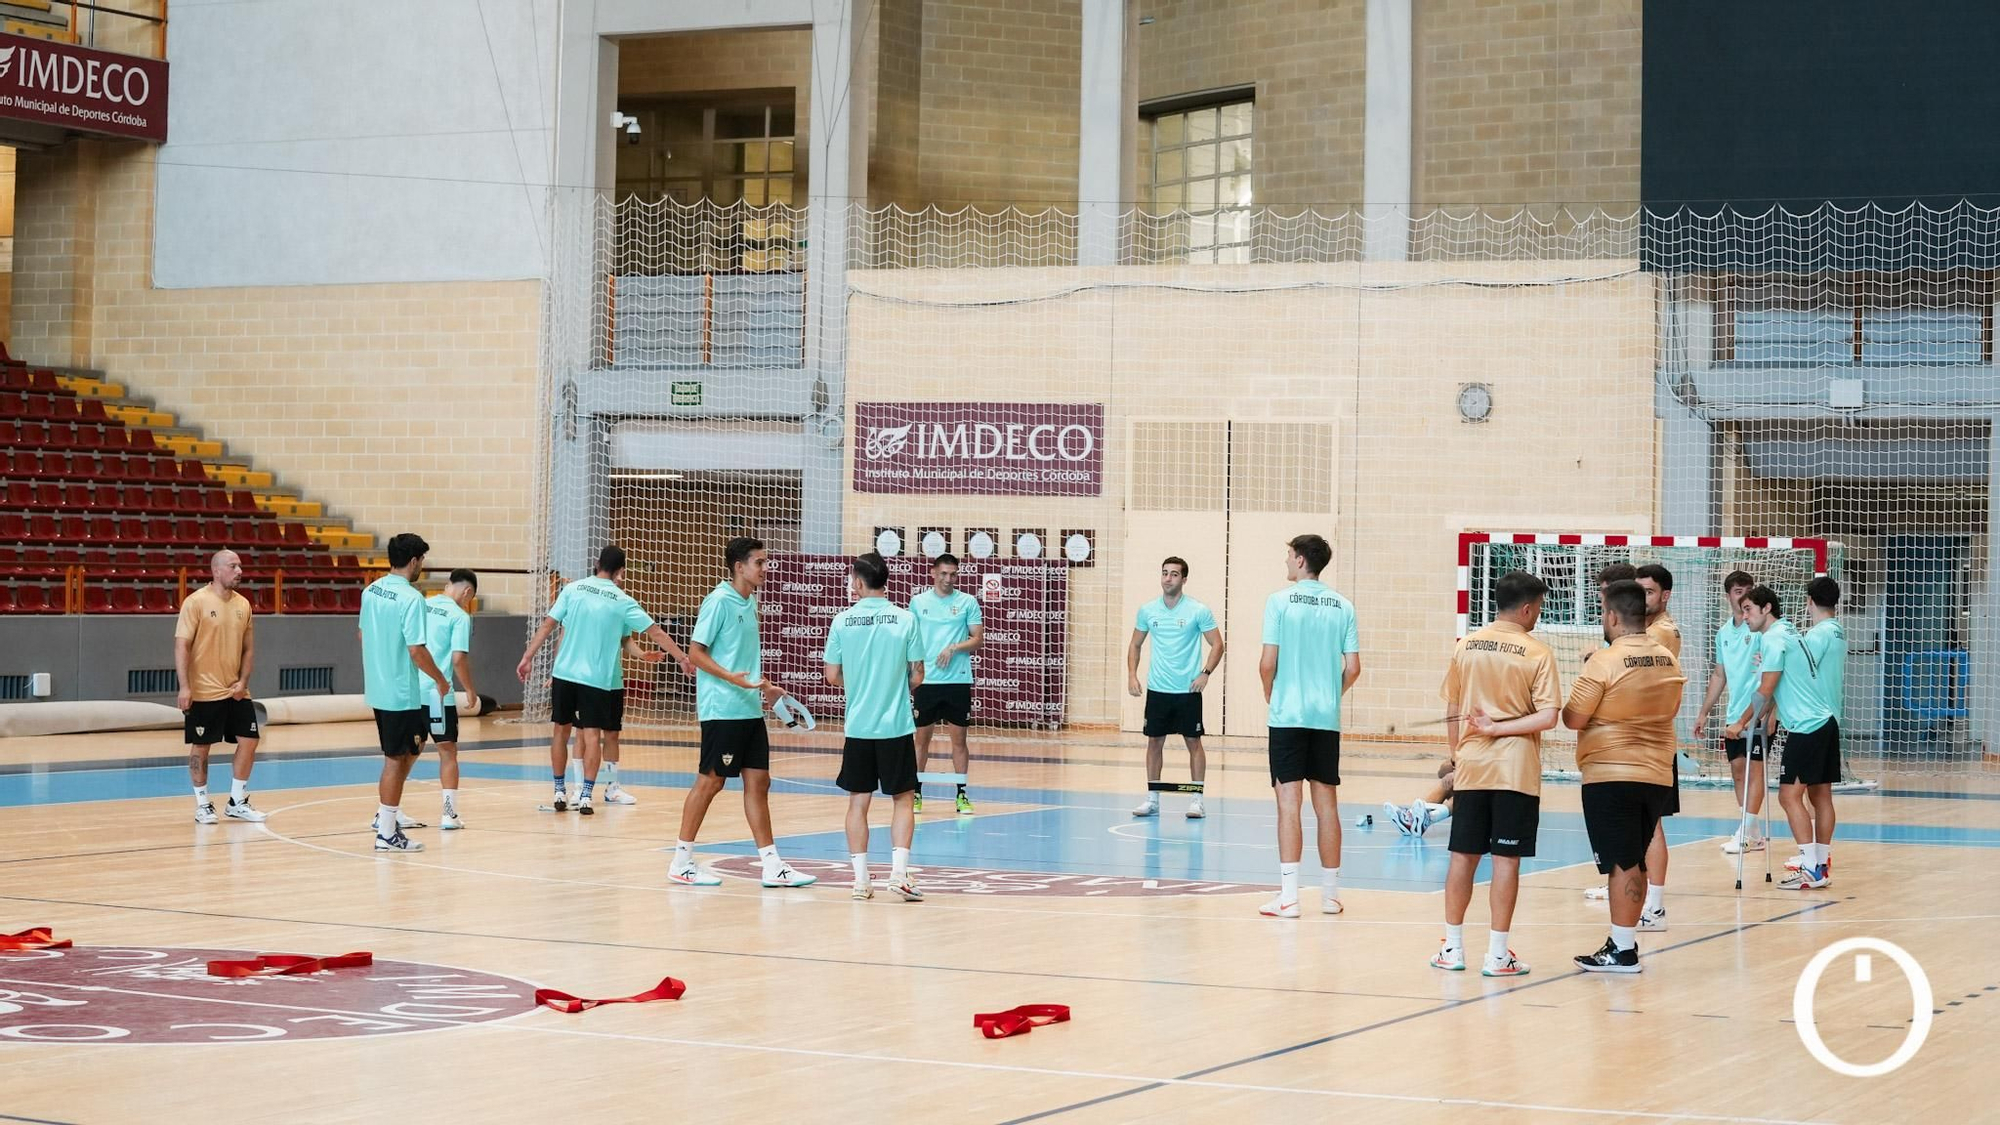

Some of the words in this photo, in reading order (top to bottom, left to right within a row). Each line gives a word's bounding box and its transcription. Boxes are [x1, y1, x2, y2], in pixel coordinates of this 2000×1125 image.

[18, 47, 149, 106] IMDECO
[14, 95, 57, 114] Municipal
[58, 102, 70, 115] de
[72, 105, 110, 122] Deportes
[111, 111, 147, 127] Córdoba
[916, 424, 1094, 461] IMDECO
[865, 467, 910, 479] Instituto
[913, 467, 967, 481] Municipal
[969, 468, 984, 480] de
[987, 469, 1038, 481] Deportes
[876, 615, 898, 625] FUTSAL
[1465, 638, 1498, 651] CÓRDOBA
[1500, 642, 1526, 657] FUTSAL
[1624, 655, 1654, 668] CÓRDOBA
